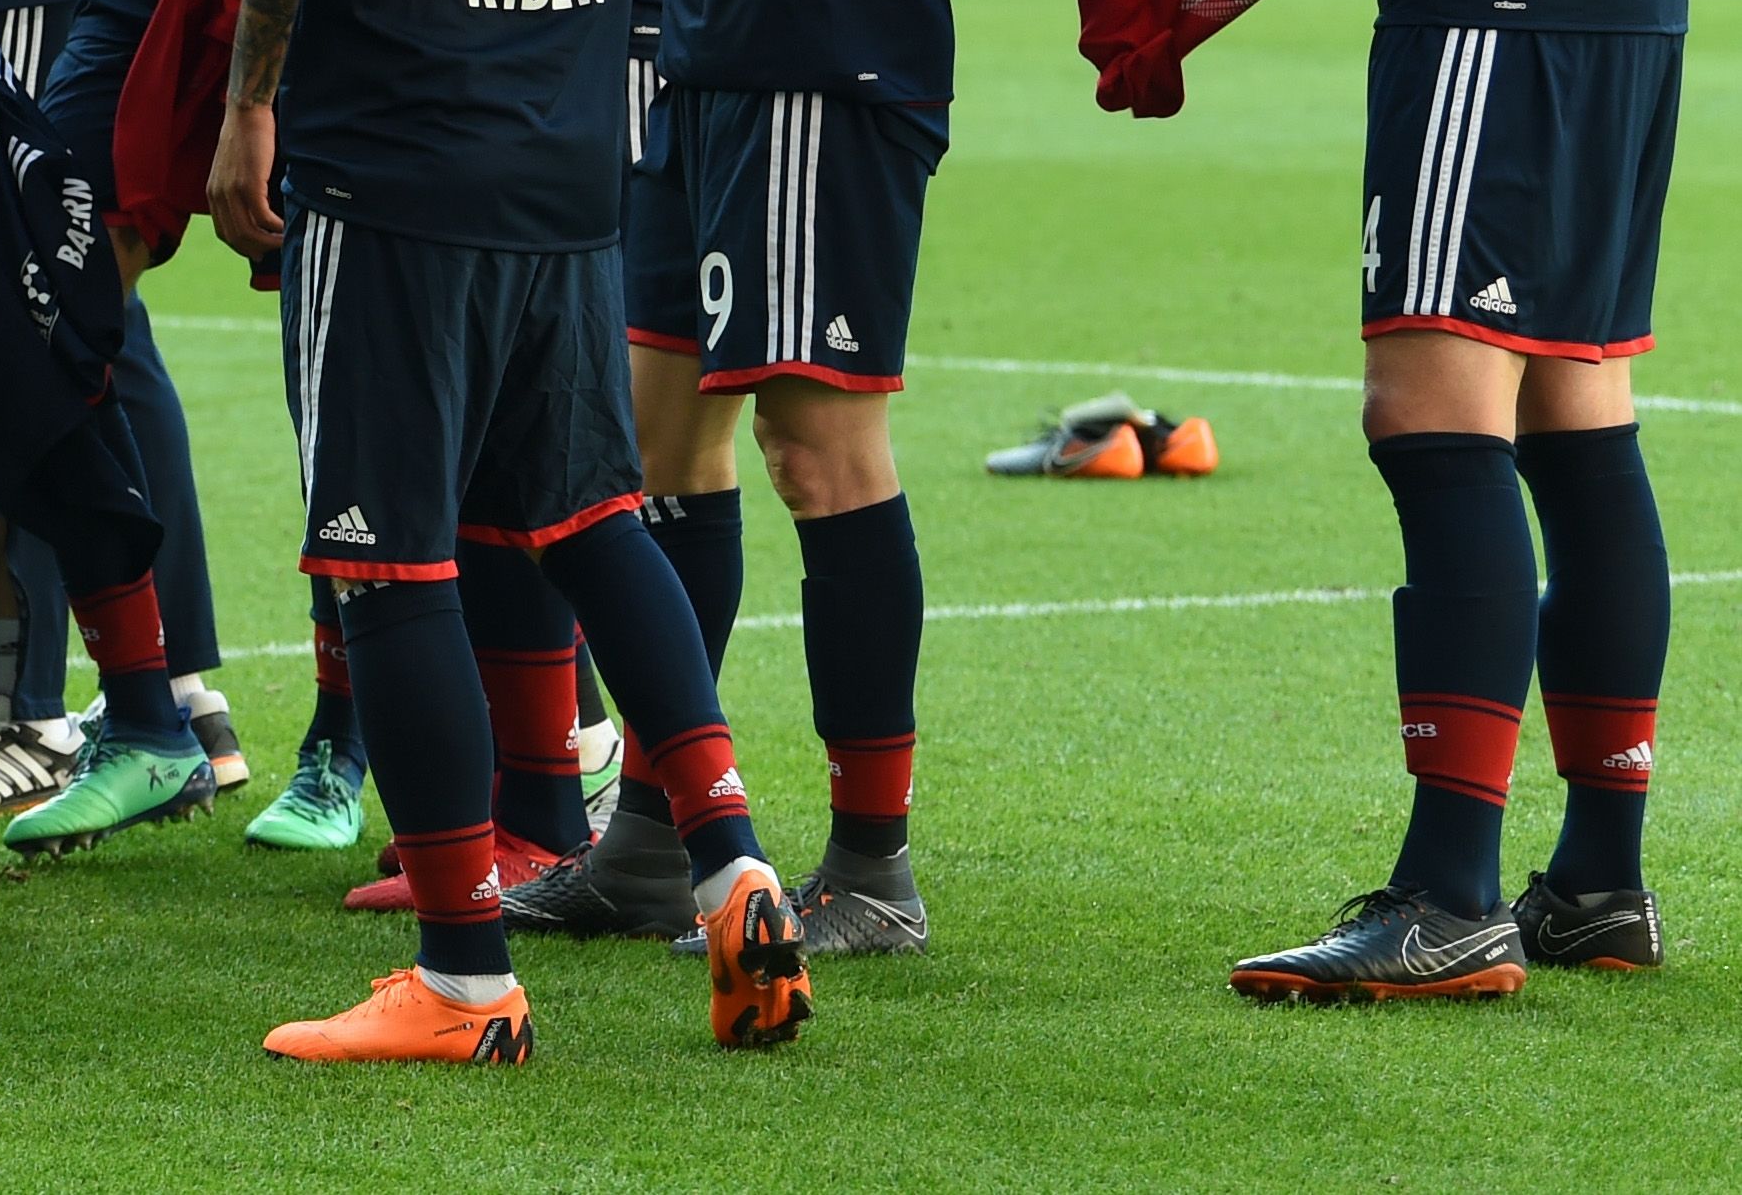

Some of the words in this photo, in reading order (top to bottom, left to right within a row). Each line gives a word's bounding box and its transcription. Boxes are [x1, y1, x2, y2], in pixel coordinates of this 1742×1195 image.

[1362, 195, 1381, 294] 4
[699, 251, 734, 352] 9
[1469, 294, 1517, 315] adidas
[319, 524, 376, 545] adidas
[319, 640, 347, 661] FC
[1401, 723, 1437, 738] CB
[1602, 758, 1654, 771] adida
[1643, 896, 1659, 953] TIEMPO
